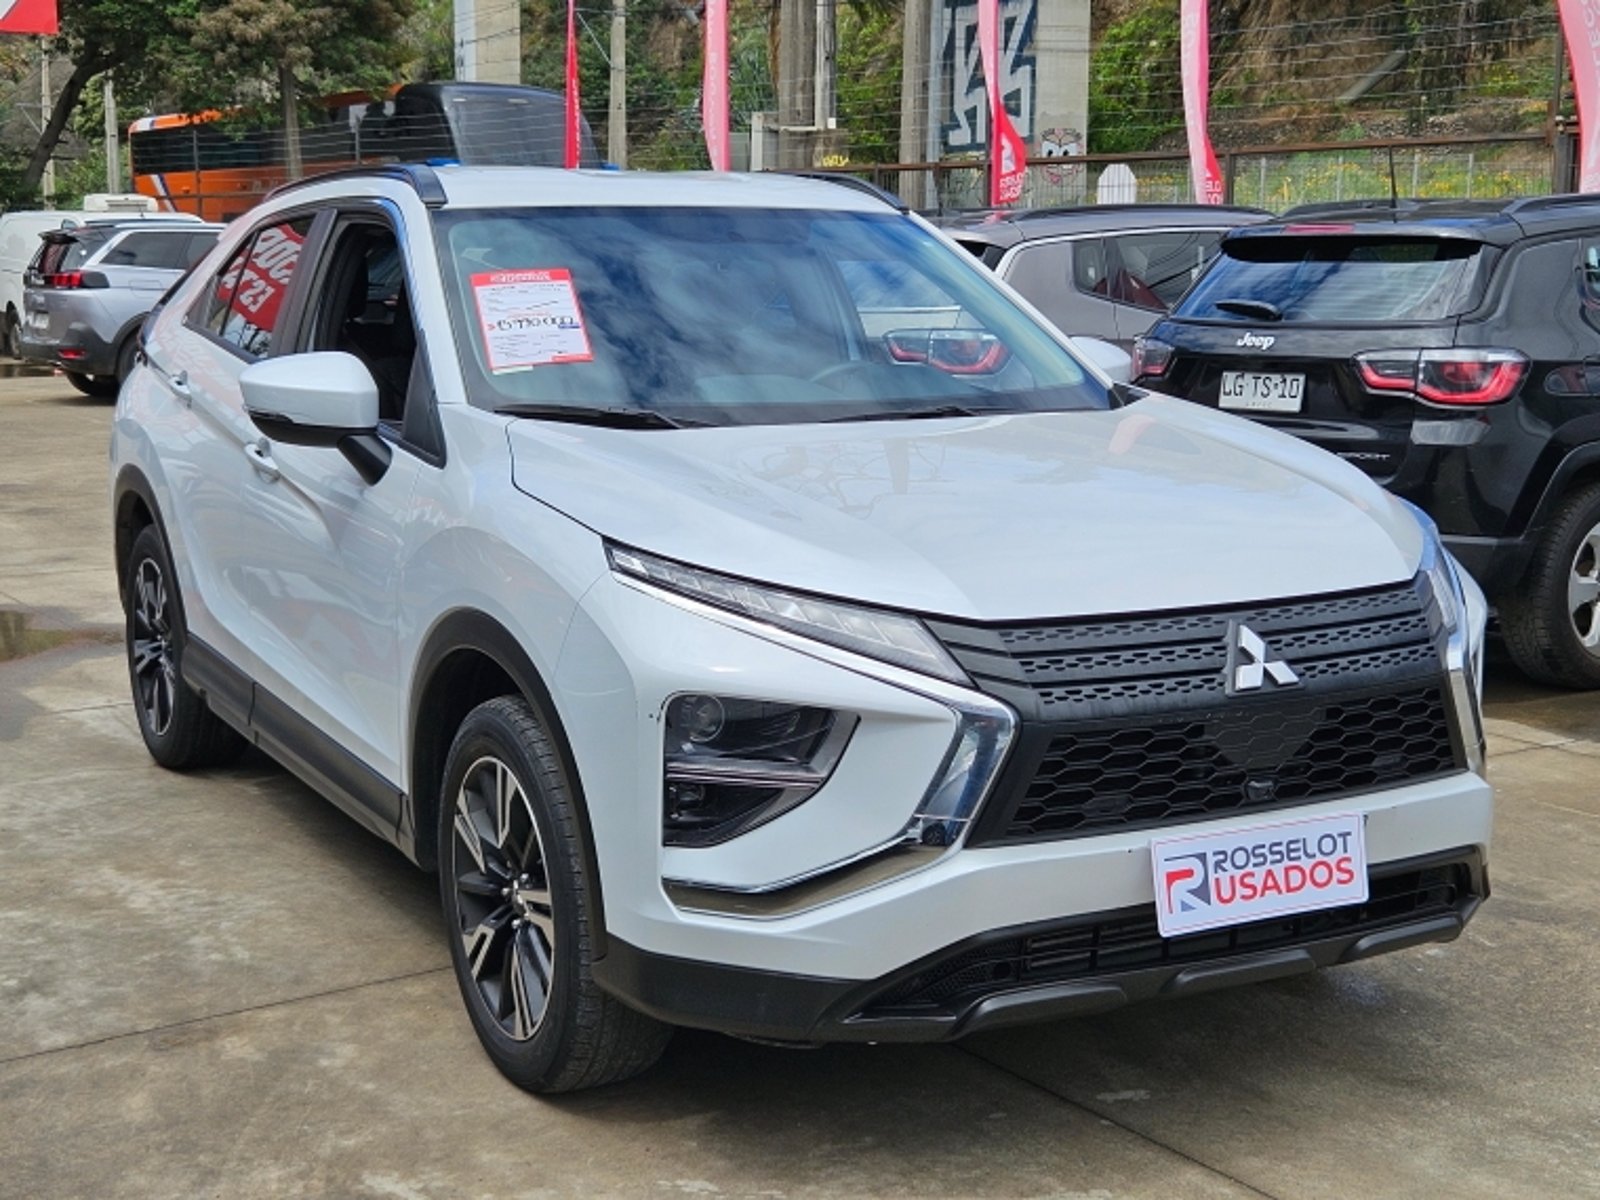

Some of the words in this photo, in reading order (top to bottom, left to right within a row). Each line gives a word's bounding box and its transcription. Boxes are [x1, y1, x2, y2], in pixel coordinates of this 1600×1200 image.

[1236, 332, 1275, 350] Jeep
[1212, 831, 1353, 874] ROSSELOT
[1214, 856, 1355, 905] USADOS
